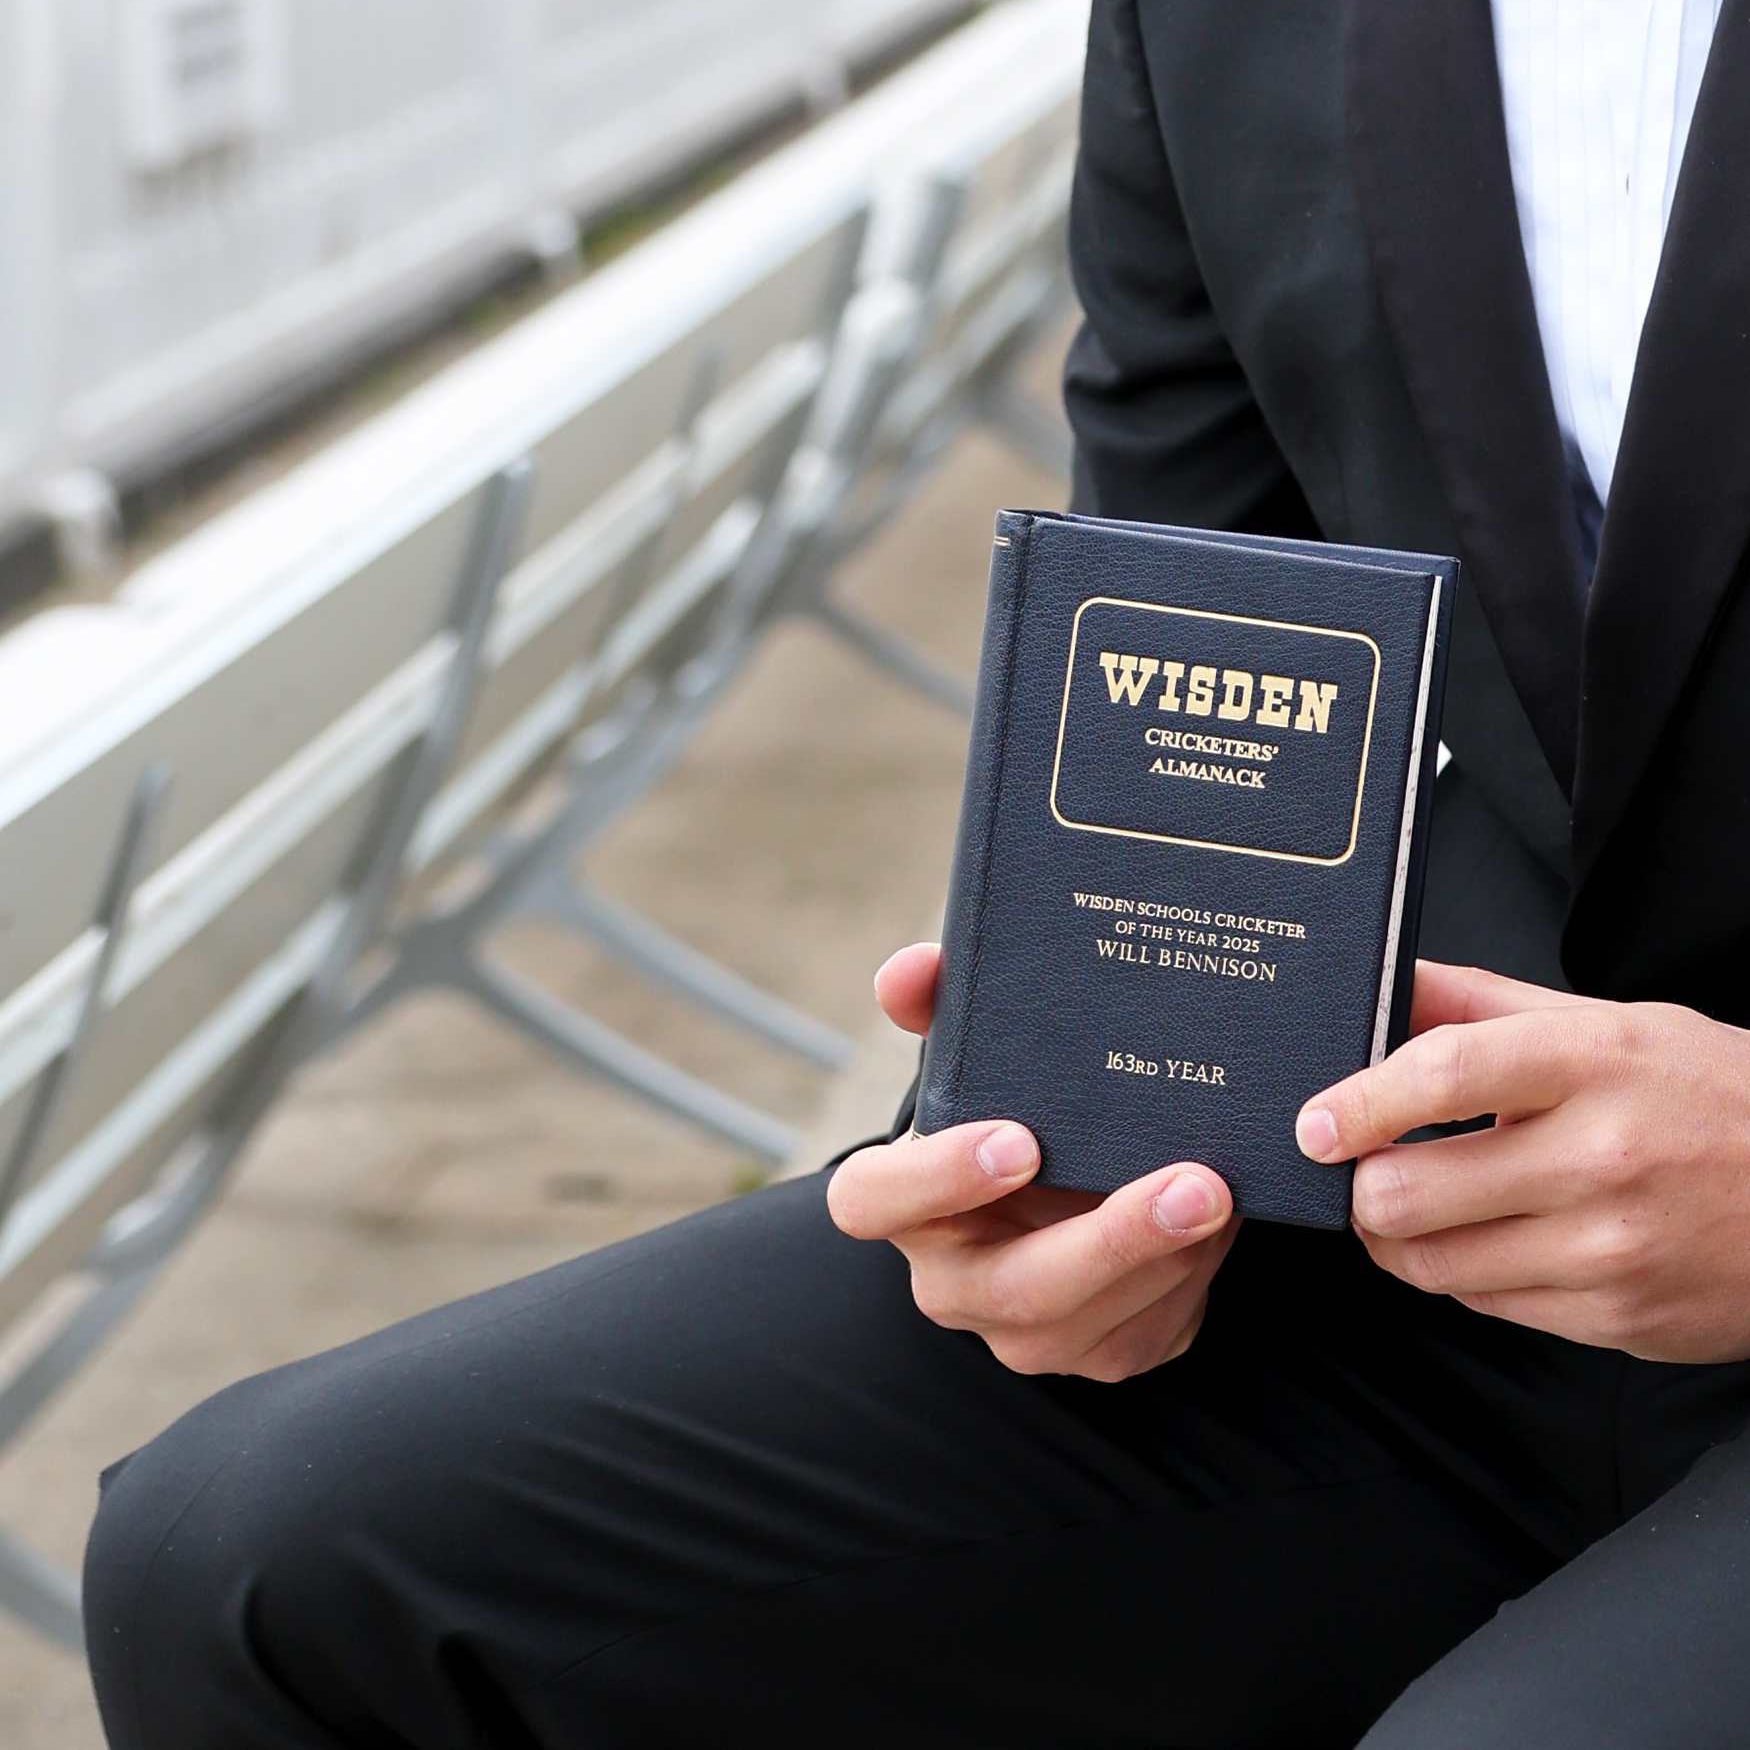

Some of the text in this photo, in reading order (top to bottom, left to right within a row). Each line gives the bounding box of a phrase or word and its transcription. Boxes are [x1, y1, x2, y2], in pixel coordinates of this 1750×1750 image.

[1099, 652, 1338, 733] WISDEN
[1145, 728, 1279, 762] CRICKETERS'
[1149, 758, 1266, 789] ALMANACK
[1073, 892, 1306, 939] WISDEN SCHOOLS CRICKETER
[1115, 920, 1260, 953] OF THE YEAR 2025
[1096, 939, 1277, 982] WILL BENNISON
[1105, 1051, 1226, 1085] 163RD YEAR
